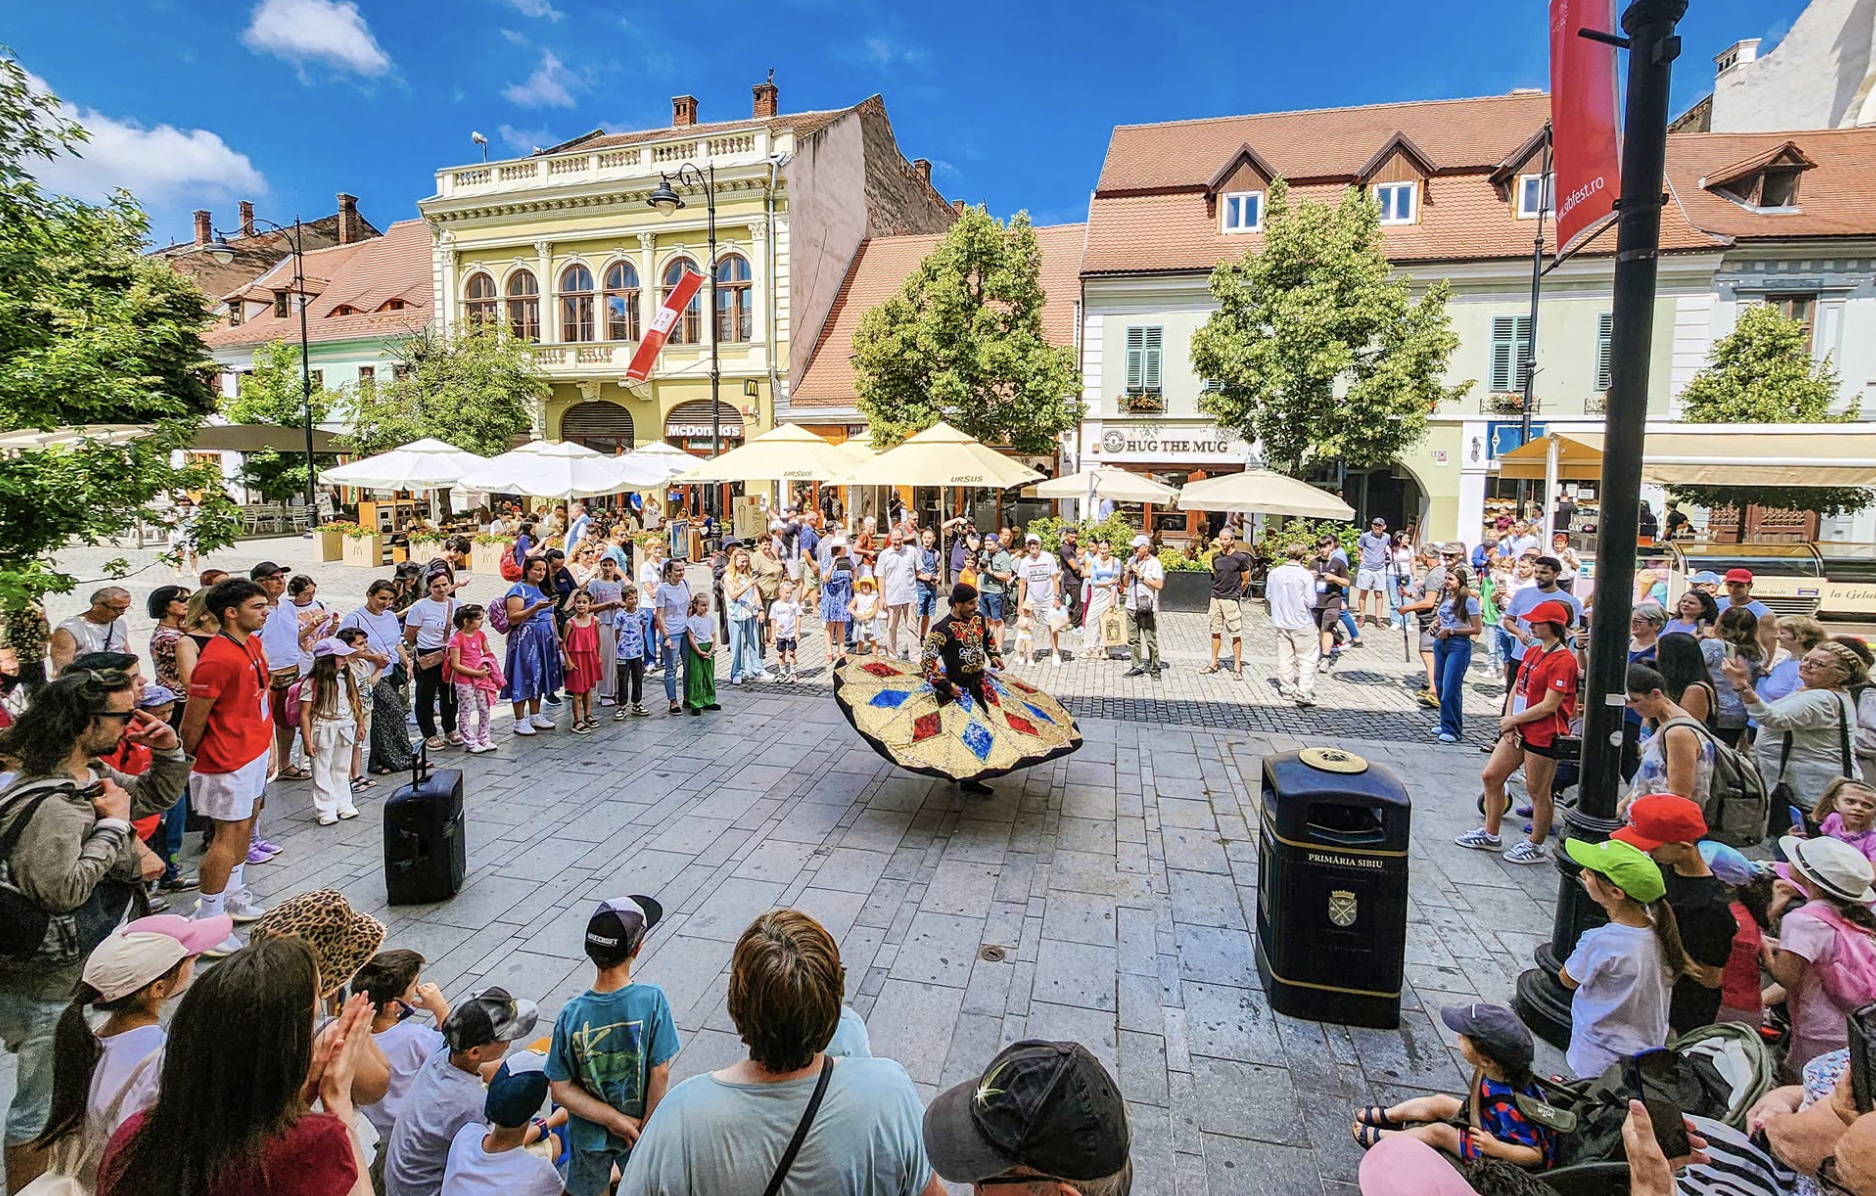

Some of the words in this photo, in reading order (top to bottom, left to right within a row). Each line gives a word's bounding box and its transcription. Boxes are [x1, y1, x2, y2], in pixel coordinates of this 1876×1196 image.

[1126, 440, 1158, 452] HUG
[1161, 440, 1190, 452] THE
[1192, 440, 1228, 453] MUG
[951, 475, 983, 483] URSUS
[1830, 589, 1842, 598] la
[1308, 853, 1356, 866] PRIMĂRIA
[1357, 859, 1383, 869] SIBIU
